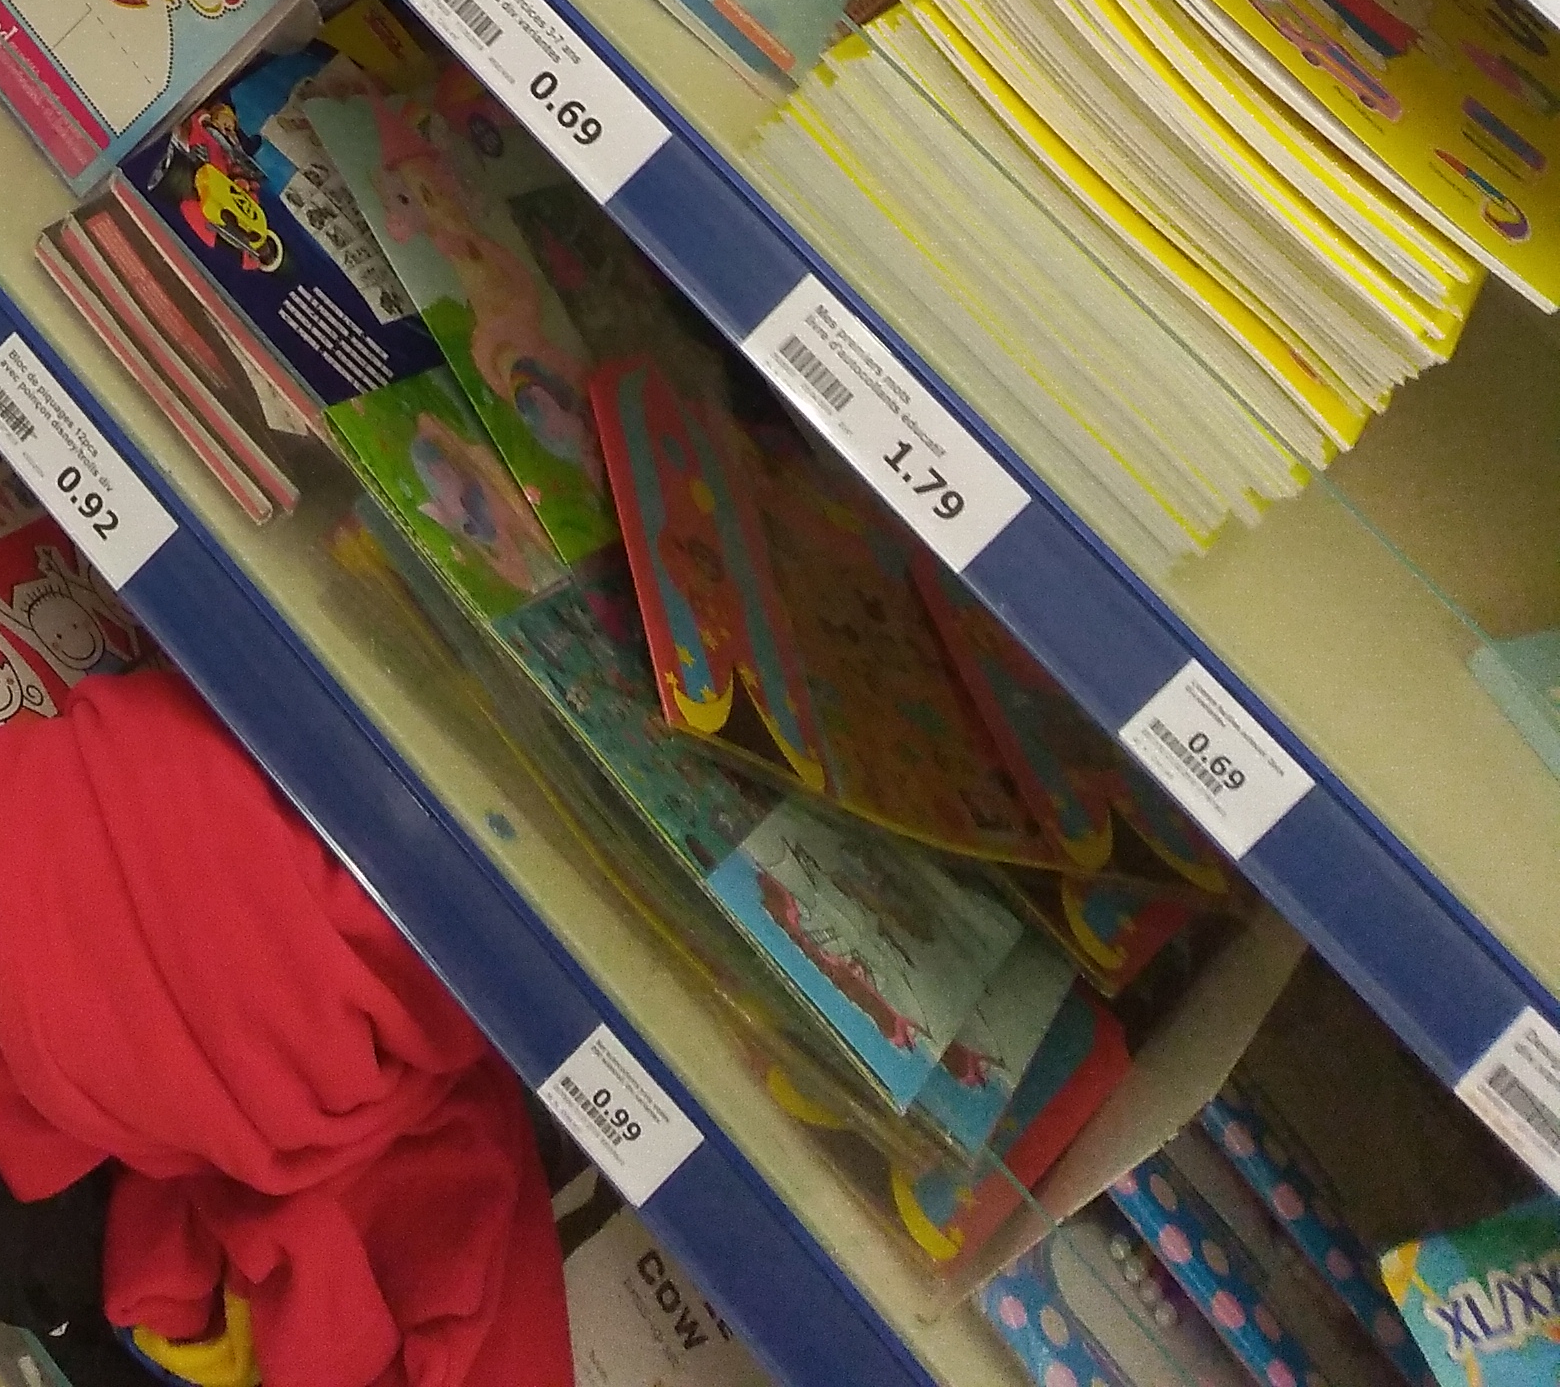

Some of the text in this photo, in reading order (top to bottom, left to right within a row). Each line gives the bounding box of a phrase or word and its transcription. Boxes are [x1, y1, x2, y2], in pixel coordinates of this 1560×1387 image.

[545, 26, 565, 47] 3-7
[561, 43, 583, 66] ans
[526, 69, 604, 149] 0.69
[803, 313, 831, 342] livre
[827, 338, 903, 416] d'autocollants
[813, 303, 913, 406] Mes premiers mots
[0, 358, 115, 494] avec poinçon disney/trolls div
[7, 348, 101, 460] Bloc de piquages 12pcs
[53, 463, 121, 541] 0.92
[882, 437, 966, 525] 1.79
[1187, 730, 1247, 792] 0.69
[591, 1086, 642, 1143] 0.99
[634, 1244, 713, 1353] COW
